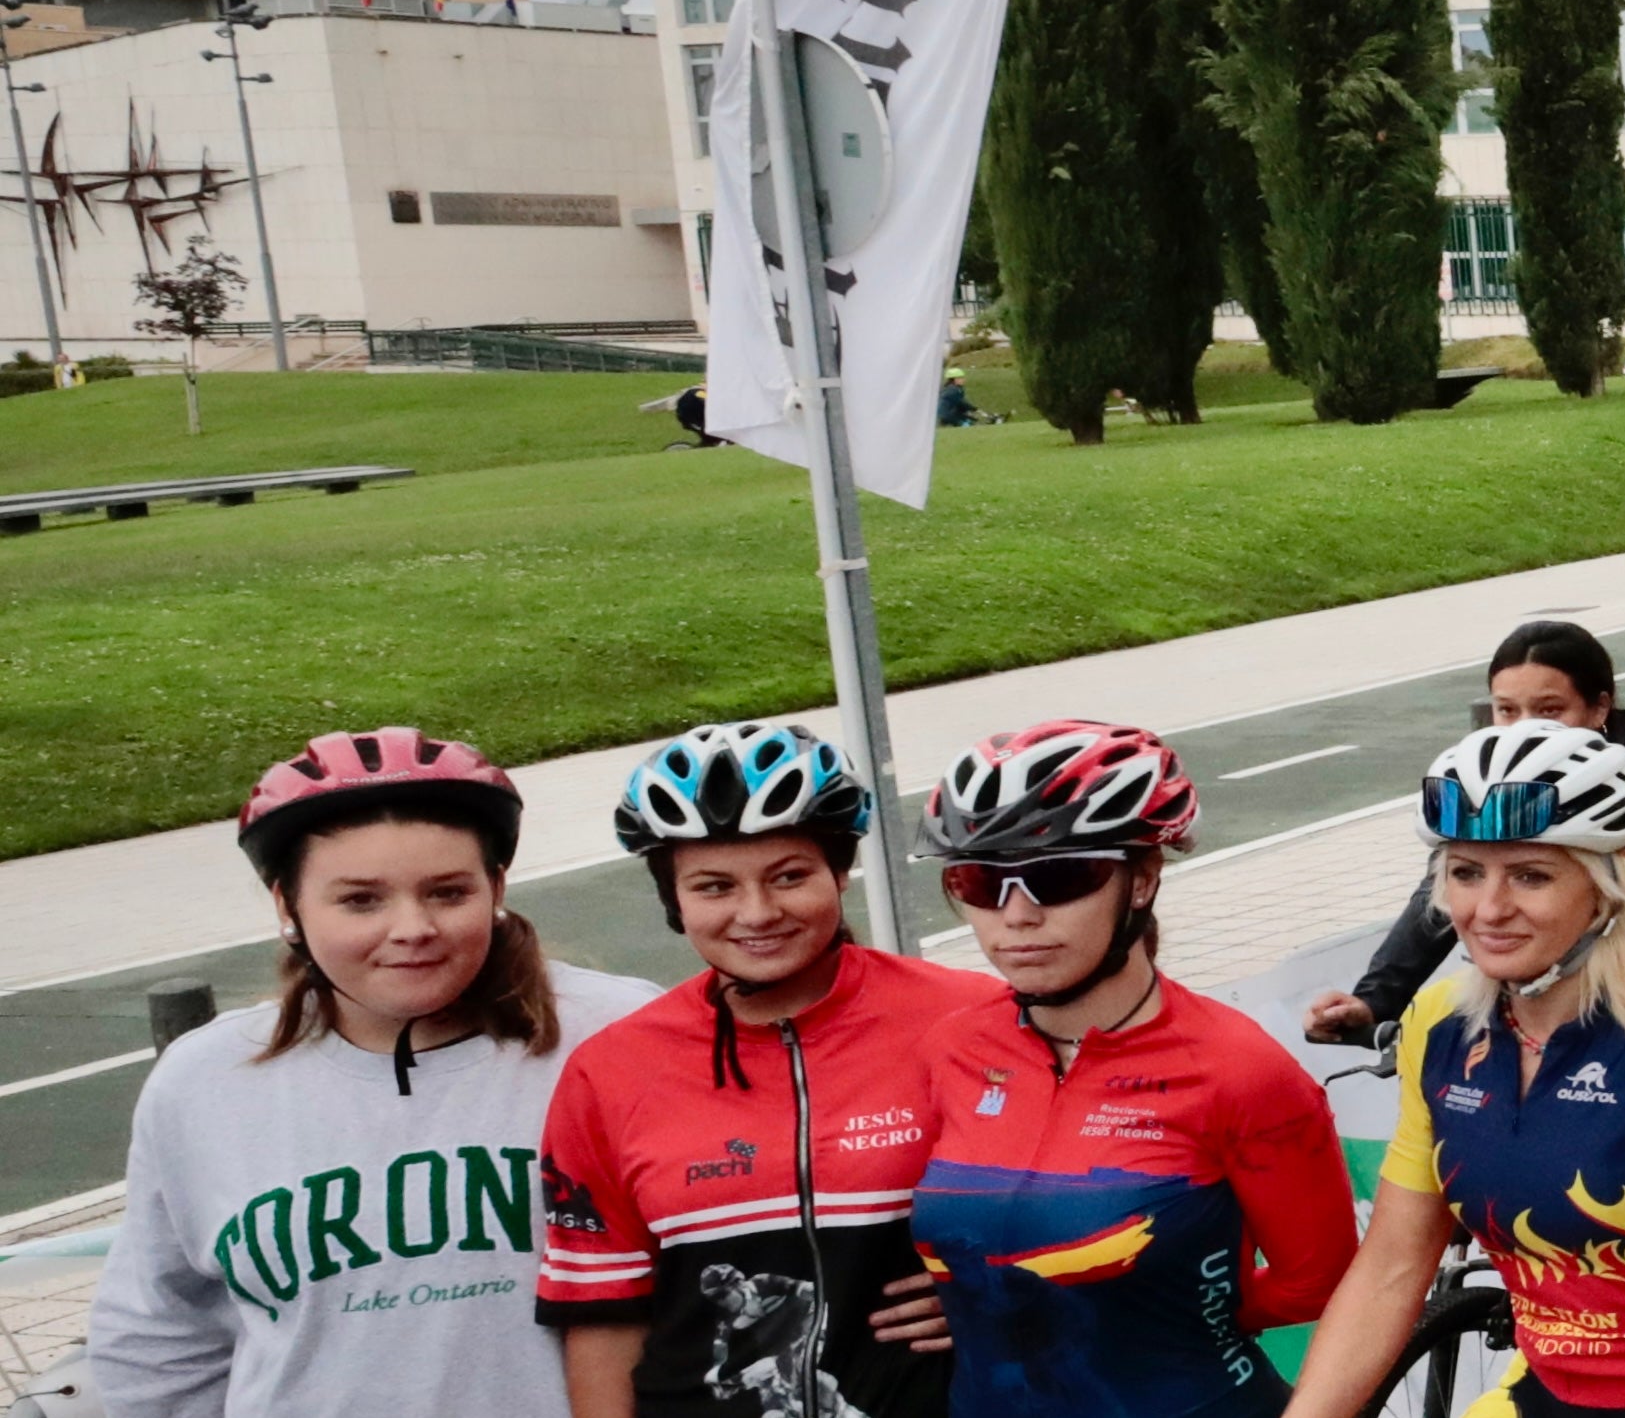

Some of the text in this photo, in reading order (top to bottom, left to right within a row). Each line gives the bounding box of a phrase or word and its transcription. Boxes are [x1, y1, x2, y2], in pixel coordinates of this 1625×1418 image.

[844, 1106, 914, 1133] JESÚS
[1085, 1113, 1137, 1127] AMIGOS
[838, 1126, 923, 1153] NEGRO
[1115, 1127, 1164, 1141] NEGRO
[341, 1272, 517, 1315] Lake Ontario
